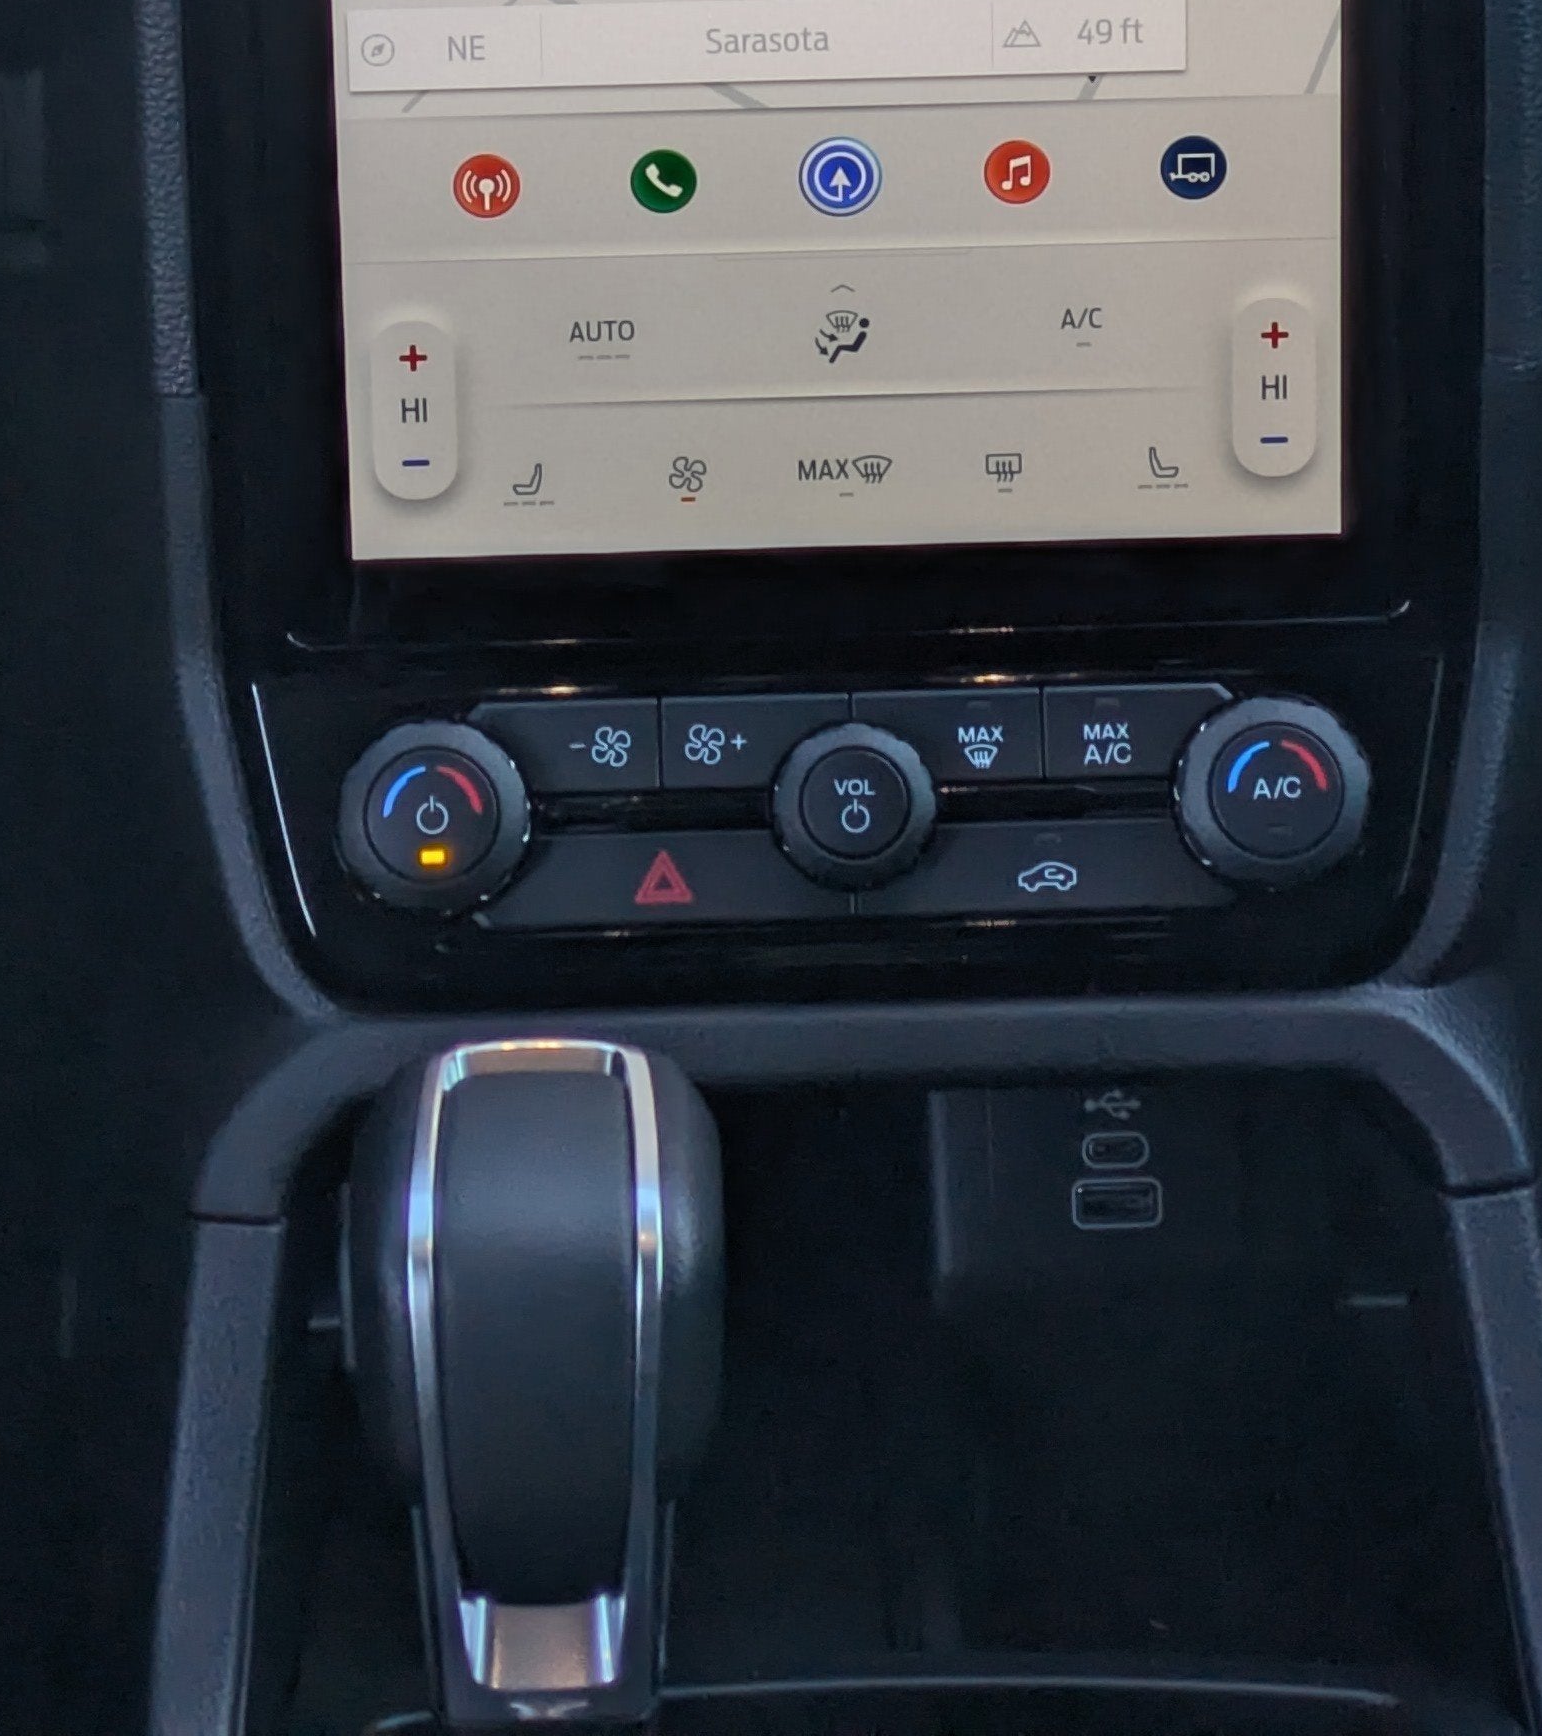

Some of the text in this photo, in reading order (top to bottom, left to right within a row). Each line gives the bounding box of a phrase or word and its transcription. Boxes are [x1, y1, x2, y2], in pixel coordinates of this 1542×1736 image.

[705, 26, 829, 56] Sarasota
[1077, 17, 1144, 45] 49 ft
[447, 34, 486, 63] NE
[1060, 306, 1103, 330] A/C
[569, 320, 636, 343] AUTO
[1260, 374, 1289, 401] HI
[401, 396, 428, 424] HI
[797, 459, 850, 482] MAX
[958, 724, 1003, 743] MAX
[1083, 722, 1130, 740] MAX
[1083, 743, 1133, 765] A/C
[834, 778, 876, 796] VOL
[1252, 776, 1302, 801] A/C
